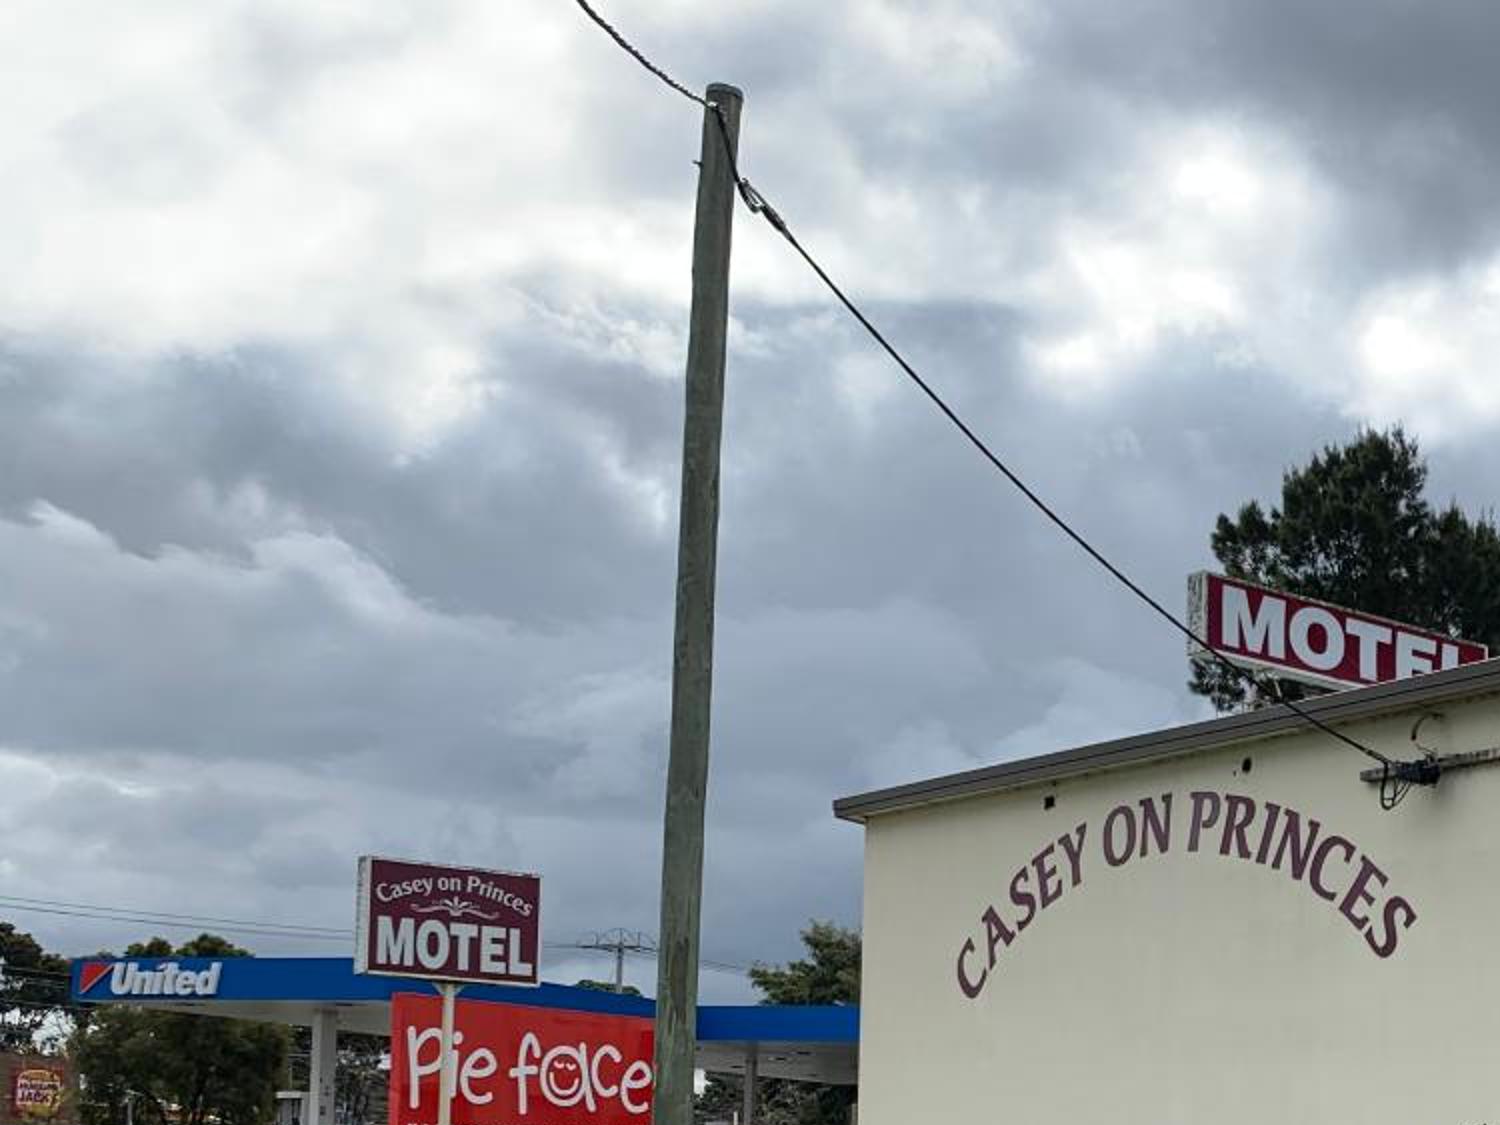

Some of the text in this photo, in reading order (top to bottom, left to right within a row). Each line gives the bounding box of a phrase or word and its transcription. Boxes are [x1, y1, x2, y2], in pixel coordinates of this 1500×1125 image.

[376, 875, 533, 917] Casey on Princes
[957, 790, 1417, 999] CASEY ON PRINCES
[376, 915, 533, 977] MOTEL
[111, 961, 223, 995] United
[509, 1031, 653, 1115] face
